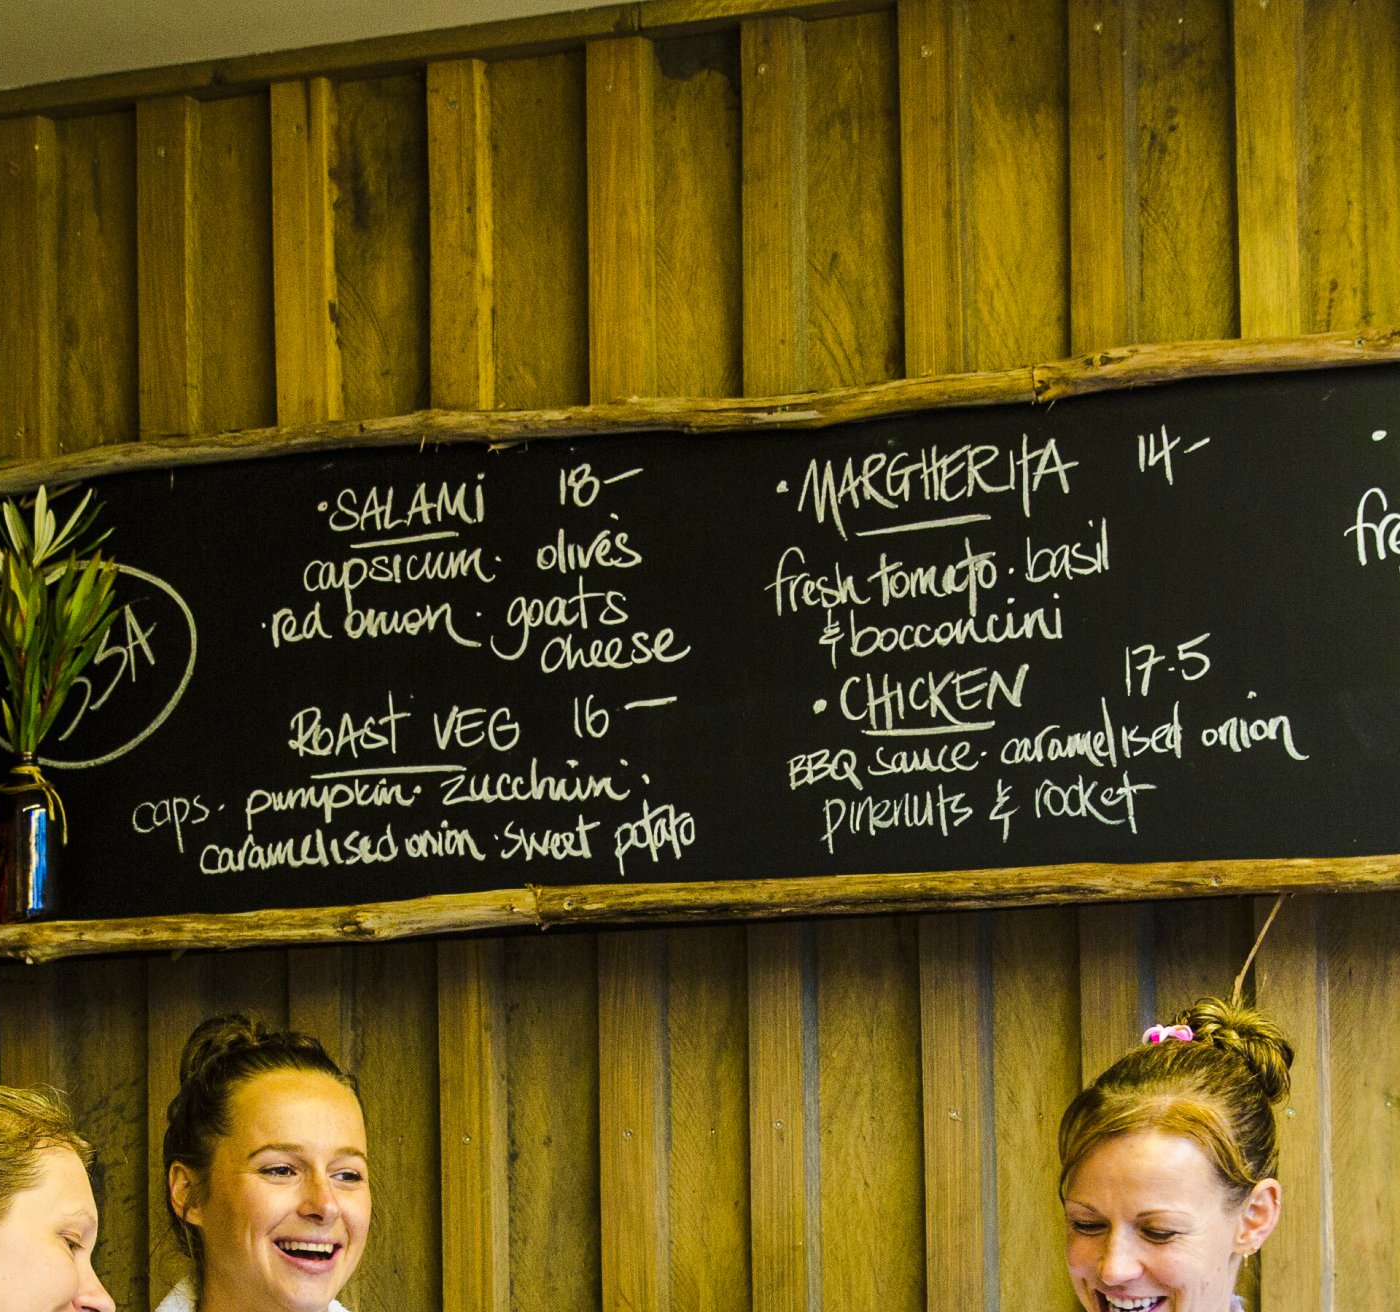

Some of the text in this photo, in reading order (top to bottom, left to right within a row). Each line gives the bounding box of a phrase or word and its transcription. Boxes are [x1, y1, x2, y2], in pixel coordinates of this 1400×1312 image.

[303, 512, 643, 614] capsicum olives
[764, 517, 1110, 616] fresh tomato basil
[271, 575, 629, 660] red onion goats
[539, 627, 692, 674] cheese
[818, 593, 1063, 670] & bocconcini
[840, 632, 1212, 729] CHICKEN 17.5
[433, 705, 521, 751] VEG
[786, 748, 864, 791] BBQ
[867, 740, 980, 777] sauce
[1201, 691, 1310, 761] onion
[245, 777, 412, 830] pumpkin
[440, 758, 631, 806] zucchini
[819, 769, 1157, 855] pinenuts & rocket
[199, 799, 697, 877] caramelised onion sweet potato
